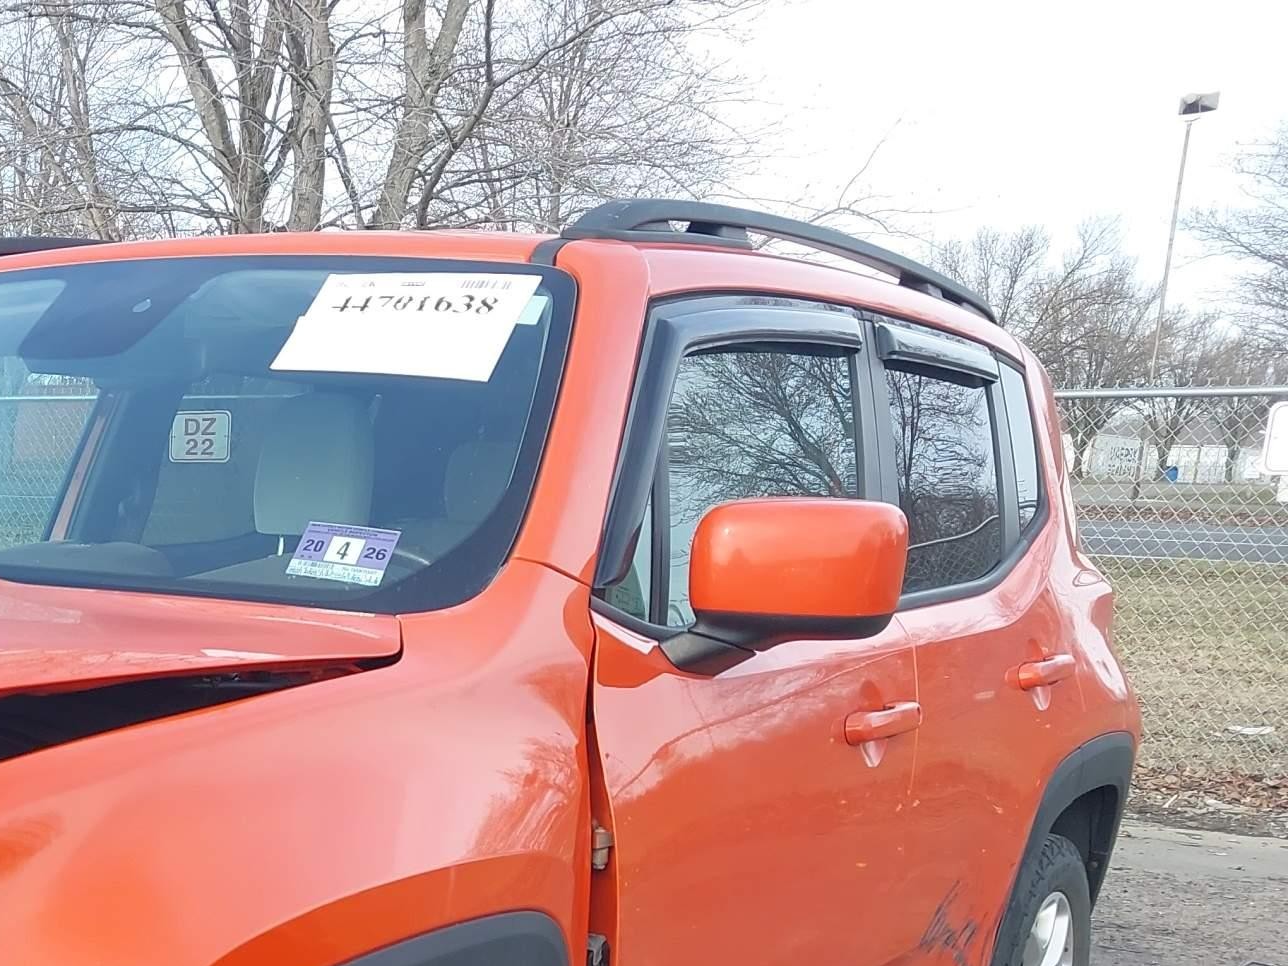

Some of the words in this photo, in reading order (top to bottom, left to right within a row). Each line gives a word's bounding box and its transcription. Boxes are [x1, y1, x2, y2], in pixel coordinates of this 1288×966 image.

[331, 294, 499, 315] 44701638
[184, 417, 217, 436] DZ
[185, 438, 215, 456] 22
[302, 538, 325, 553] 20
[336, 541, 352, 560] 4
[363, 546, 388, 561] 26
